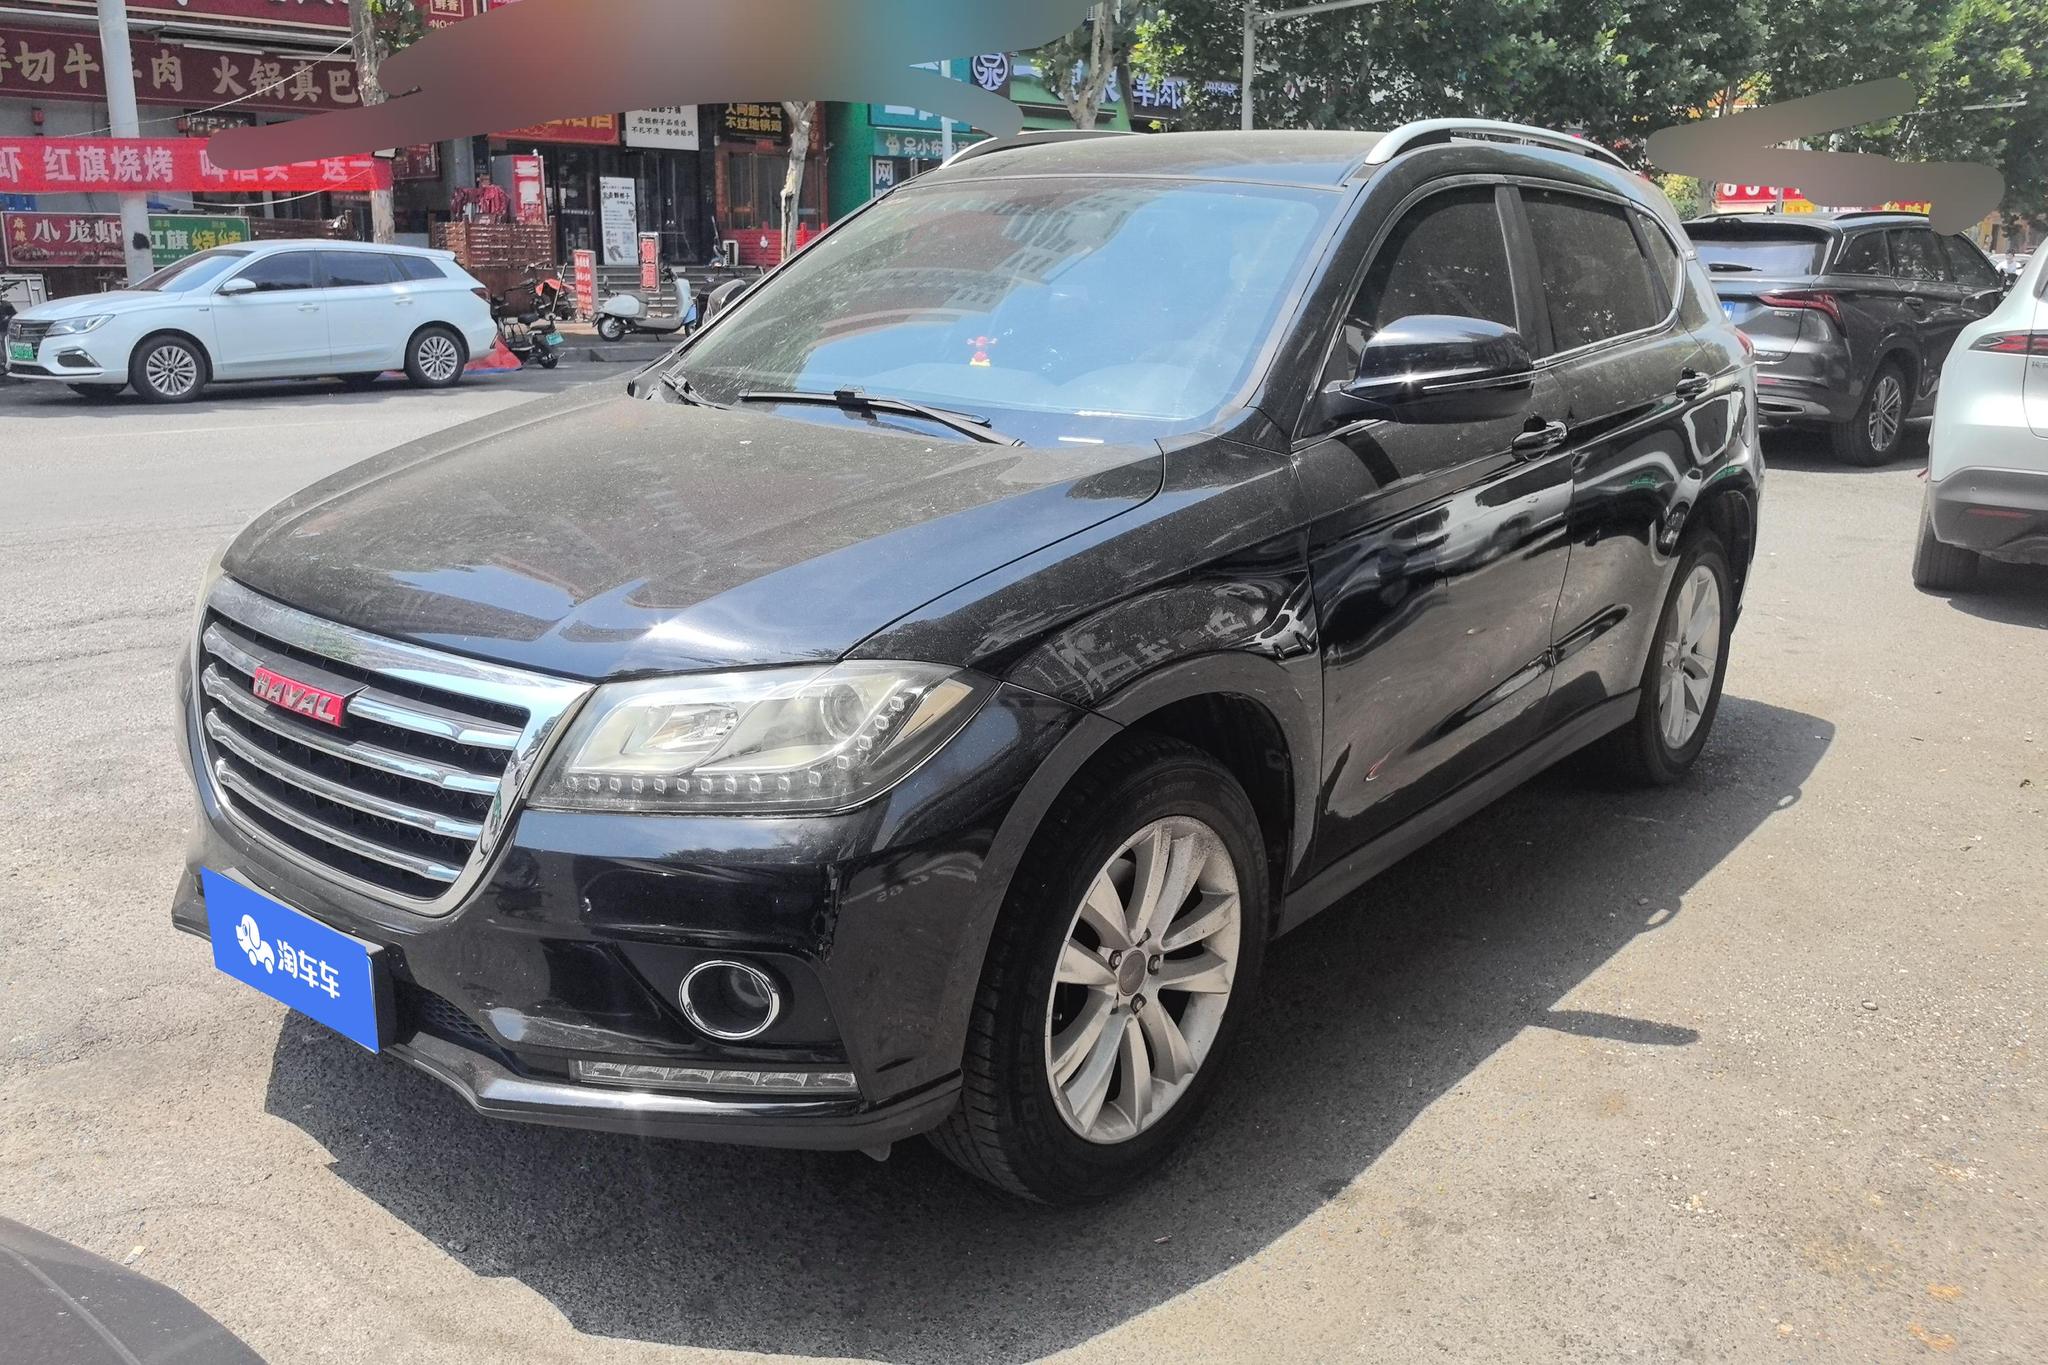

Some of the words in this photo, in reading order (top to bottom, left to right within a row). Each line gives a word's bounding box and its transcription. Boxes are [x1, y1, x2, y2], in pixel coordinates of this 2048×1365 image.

[43, 146, 174, 183] 红旗烧烤
[253, 673, 336, 721] HAVAL
